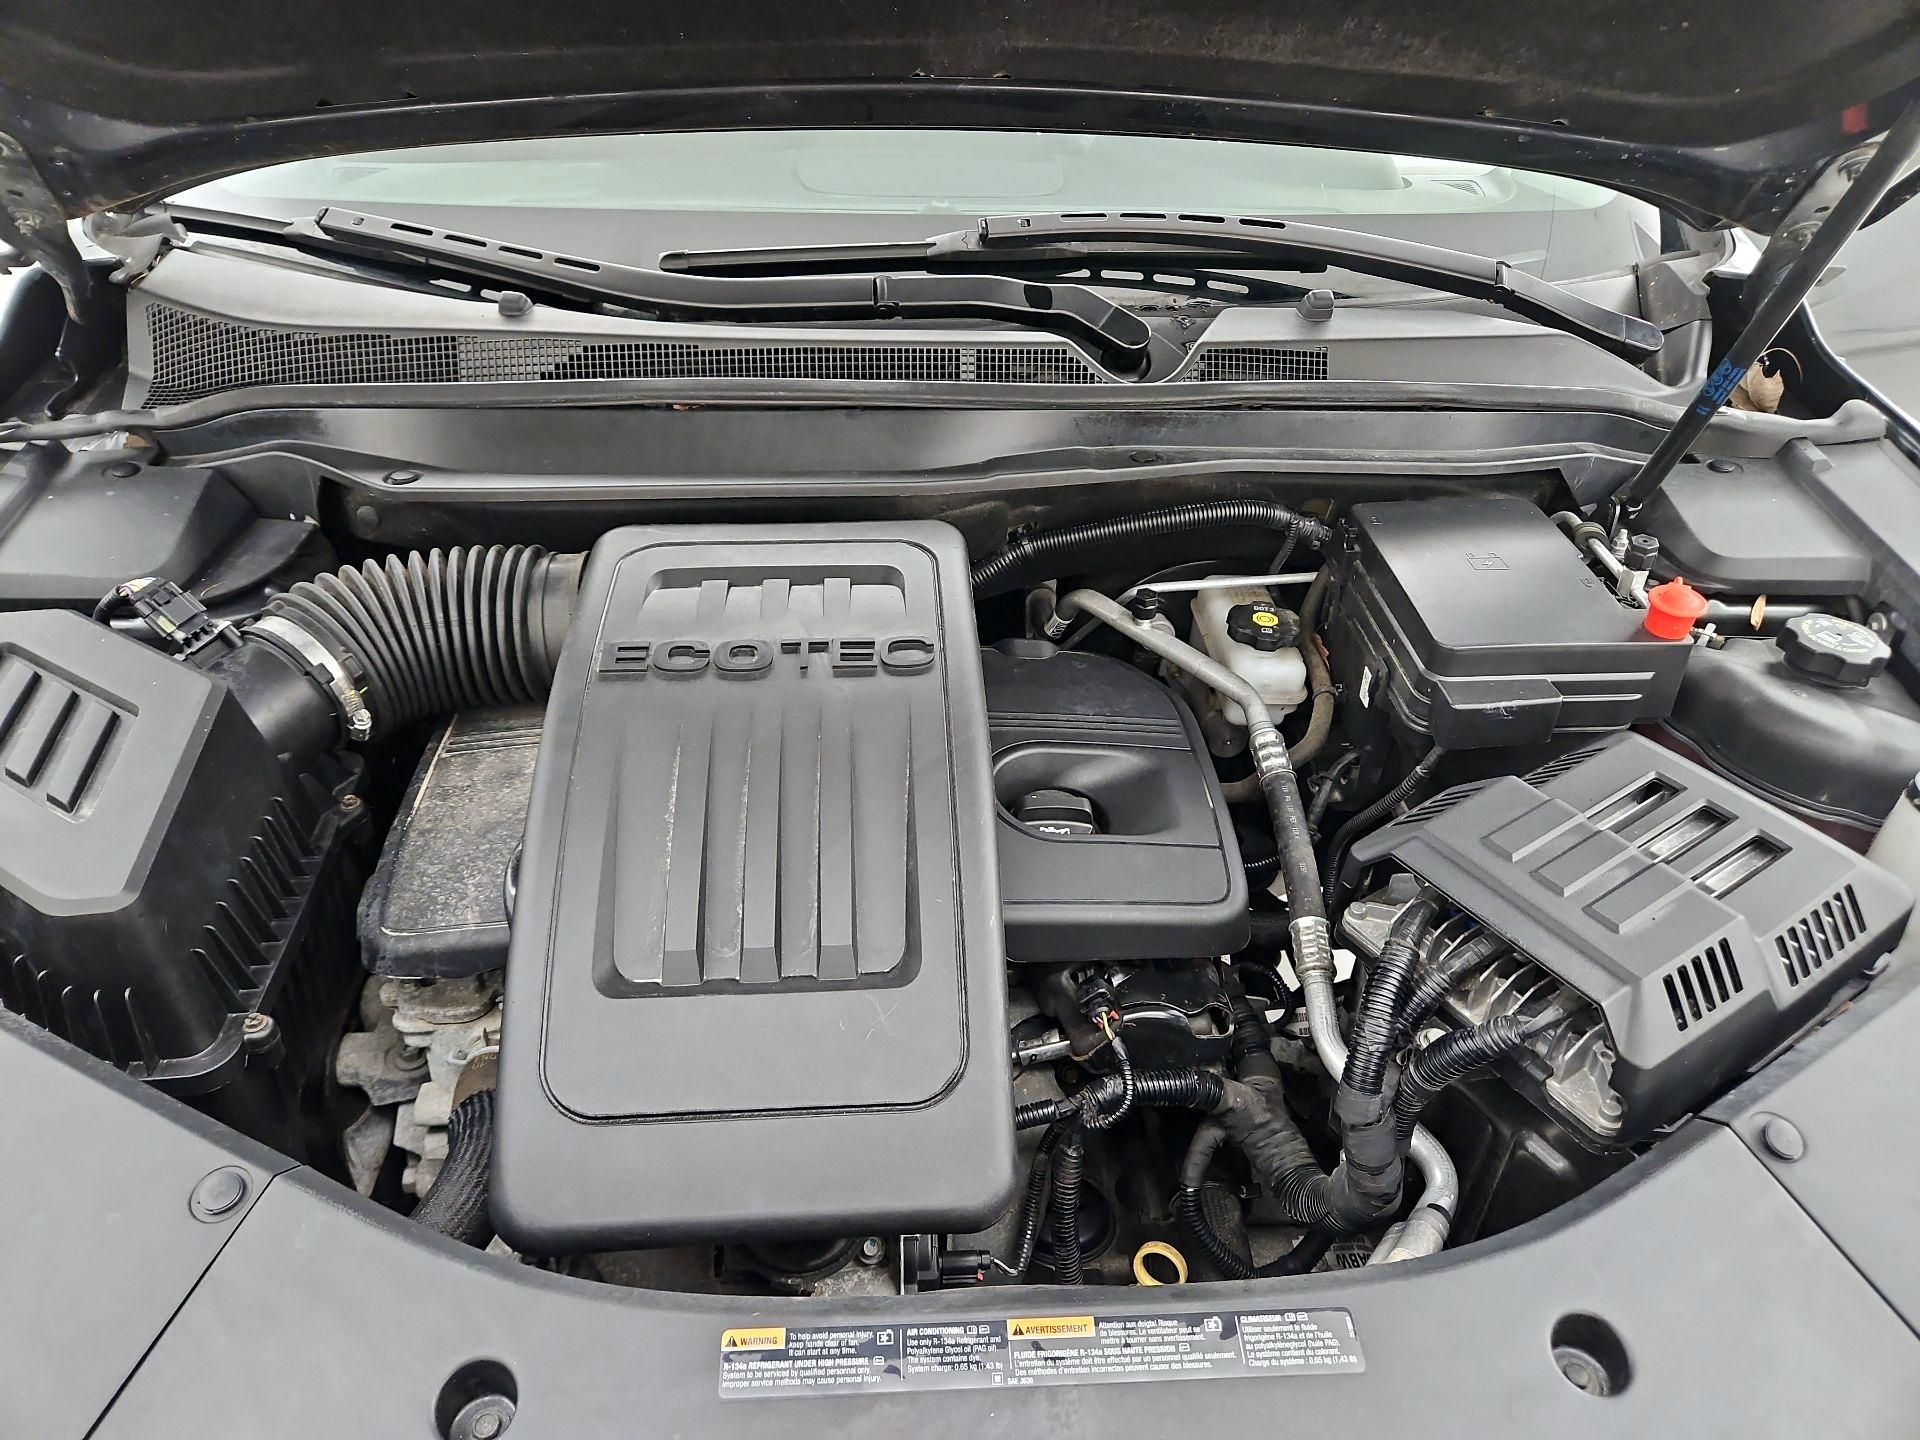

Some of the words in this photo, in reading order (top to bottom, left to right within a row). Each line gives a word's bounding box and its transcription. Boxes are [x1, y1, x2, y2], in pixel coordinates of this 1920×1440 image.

[597, 636, 935, 681] ECOTEC
[1099, 1321, 1124, 1329] Attention
[1158, 1319, 1178, 1327] Risque
[1241, 1315, 1282, 1323] CLIMATISEUR
[919, 1327, 964, 1335] CONDITIONING
[1026, 1324, 1087, 1334] AVERTISSEMENT
[798, 1332, 810, 1340] help
[830, 1331, 854, 1340] personal
[740, 1337, 777, 1345] WARNING
[789, 1341, 804, 1349] keep
[920, 1338, 931, 1346] only
[957, 1336, 988, 1344] Refrigerant
[1014, 1351, 1036, 1359] FLUIDE
[1080, 1348, 1102, 1356] R-134a
[1104, 1347, 1121, 1355] SOUS
[1122, 1346, 1143, 1354] HAUTE
[1144, 1345, 1175, 1353] PRESSION
[748, 1361, 793, 1369] REFRIGERANT
[795, 1359, 816, 1368] UNDER
[835, 1357, 869, 1366] PRESSURE
[908, 1356, 918, 1364] The
[969, 1354, 981, 1362] dye.
[1081, 1357, 1093, 1365] doit
[1132, 1355, 1141, 1364] par
[1152, 1353, 1180, 1363] personnel
[1249, 1359, 1269, 1367] Charge
[1324, 1356, 1331, 1364] kg
[908, 1365, 929, 1373] System
[970, 1363, 977, 1371] kg
[1091, 1364, 1123, 1373] incorrectes
[1125, 1363, 1148, 1372] peuvent
[722, 1372, 745, 1380] System
[791, 1369, 798, 1377] by
[800, 1368, 825, 1377] qualified
[827, 1367, 856, 1376] personnel
[722, 1380, 749, 1389] Improper
[836, 1376, 862, 1384] personal
